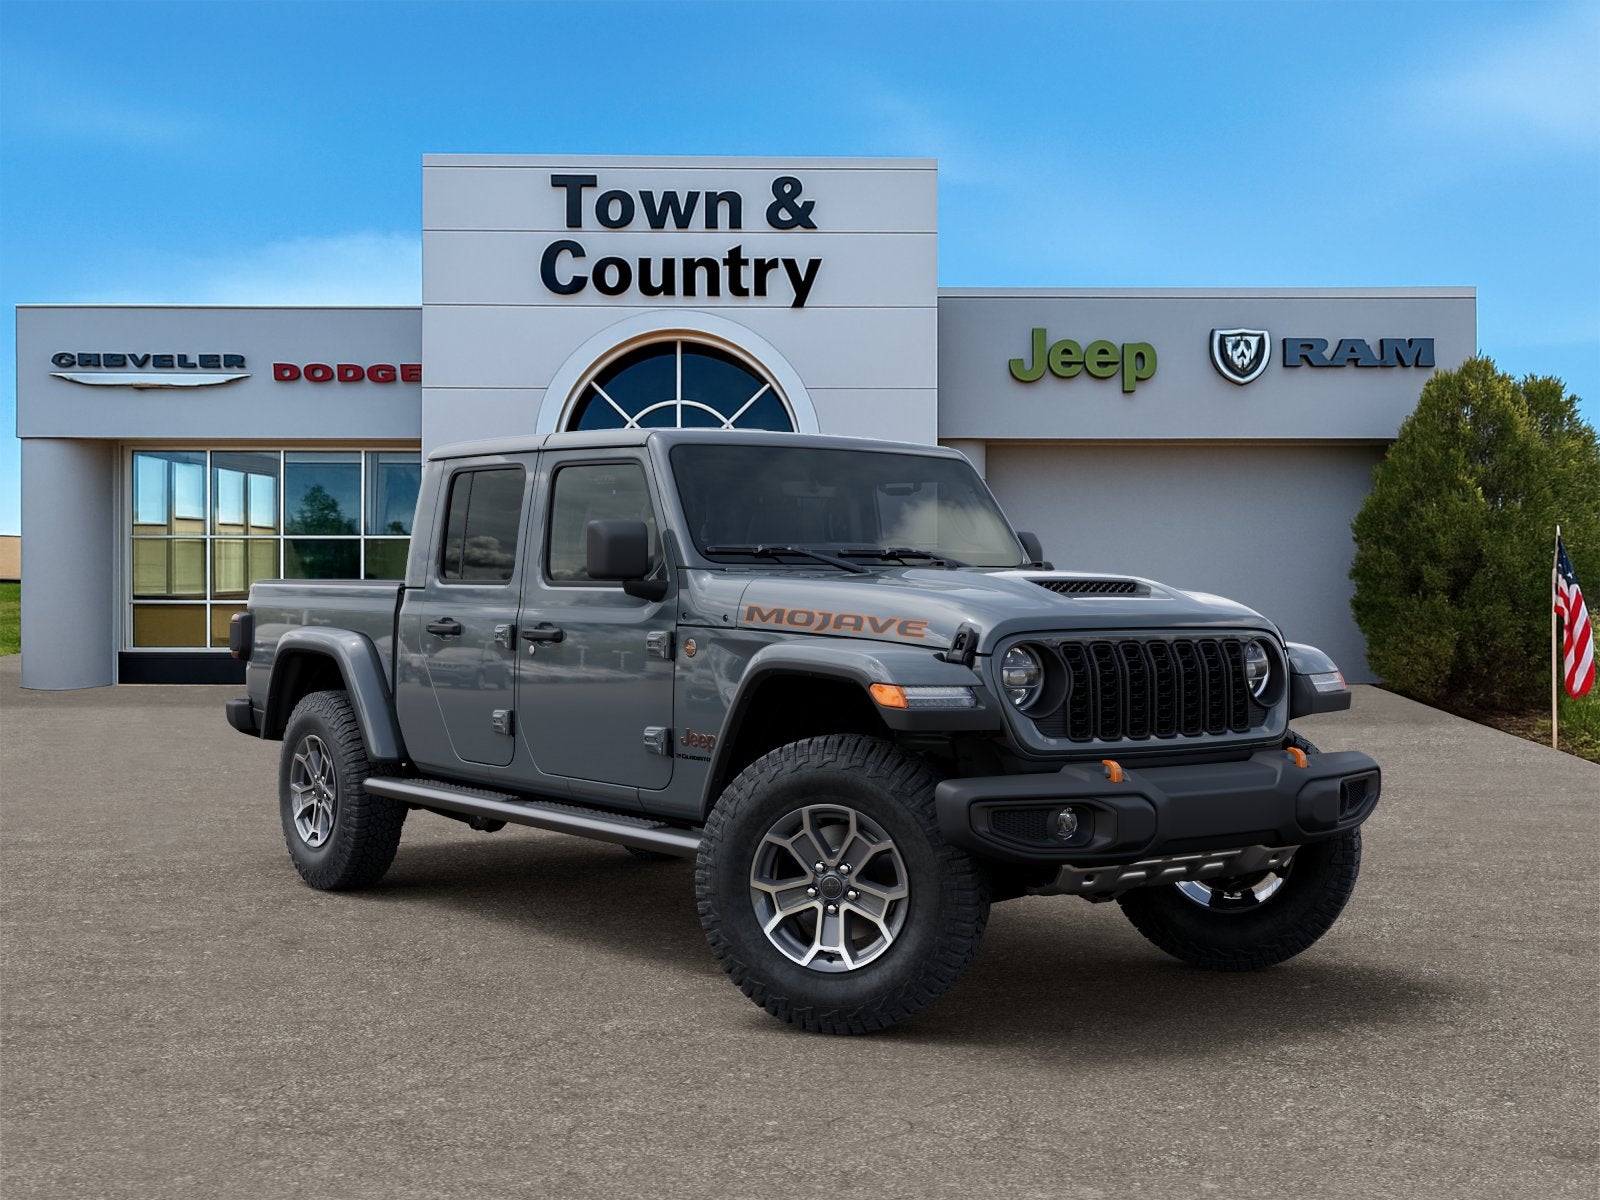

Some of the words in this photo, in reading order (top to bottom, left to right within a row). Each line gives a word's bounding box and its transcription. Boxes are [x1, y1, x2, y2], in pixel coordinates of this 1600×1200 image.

[550, 174, 743, 229] Town
[765, 176, 819, 230] &
[539, 239, 822, 308] Country
[1009, 328, 1158, 393] Jeep
[1282, 337, 1436, 368] RAM
[272, 363, 422, 384] DODGE
[744, 605, 930, 639] MOJAVE
[680, 727, 716, 753] Jeep
